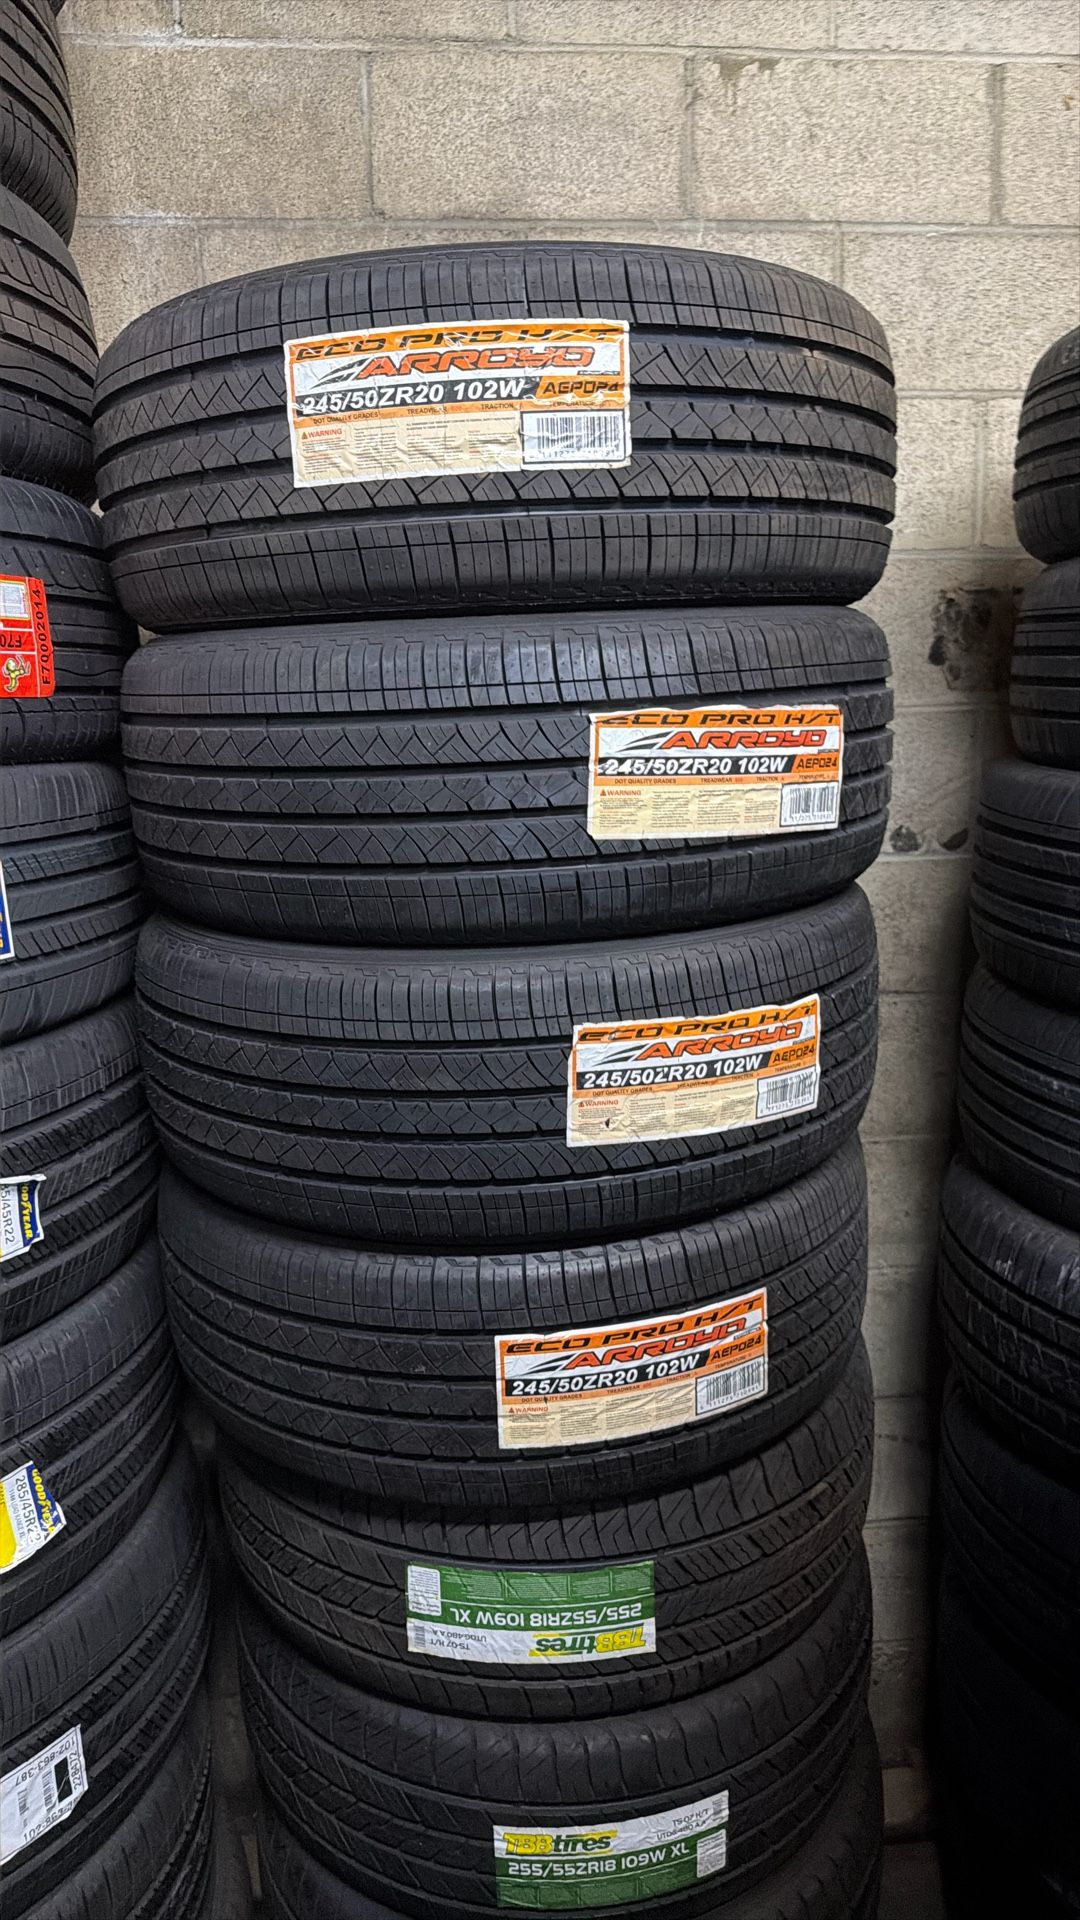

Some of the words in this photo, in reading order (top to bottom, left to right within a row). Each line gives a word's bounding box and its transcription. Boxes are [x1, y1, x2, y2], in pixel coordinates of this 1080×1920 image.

[296, 338, 386, 361] ECO
[399, 330, 503, 349] PRO
[354, 346, 596, 381] ARROYO
[302, 383, 444, 415] 245/50ZR20
[453, 378, 524, 400] 102W
[308, 428, 342, 438] WARNING
[700, 713, 776, 725] PRO
[784, 713, 839, 725] H/T
[656, 729, 827, 750] ARROYO
[605, 757, 731, 775] 245/50ZR20
[739, 757, 788, 774] 102W
[579, 1025, 663, 1041] ECO
[673, 1017, 749, 1035] PRO
[636, 1021, 803, 1061] ARROYO
[583, 1063, 707, 1089] 245/50ZR20
[714, 1054, 763, 1076] 102W
[586, 1099, 618, 1108] WARNING
[506, 1338, 592, 1354] ECO
[602, 1322, 684, 1345] PRO
[695, 1296, 762, 1327] H/T
[561, 1317, 747, 1371] ARROYO
[512, 1368, 638, 1396] 245/50ZR20
[646, 1353, 700, 1380] 102W
[607, 1384, 640, 1394] TREADWEAR
[516, 1406, 548, 1414] WARNING
[449, 1608, 471, 1623] XL
[476, 1611, 525, 1627] 109W
[529, 1602, 642, 1627] 255/55ZR18
[508, 1860, 616, 1878] 255/55ZR18
[621, 1848, 666, 1869] 109W
[671, 1842, 690, 1858] XL
